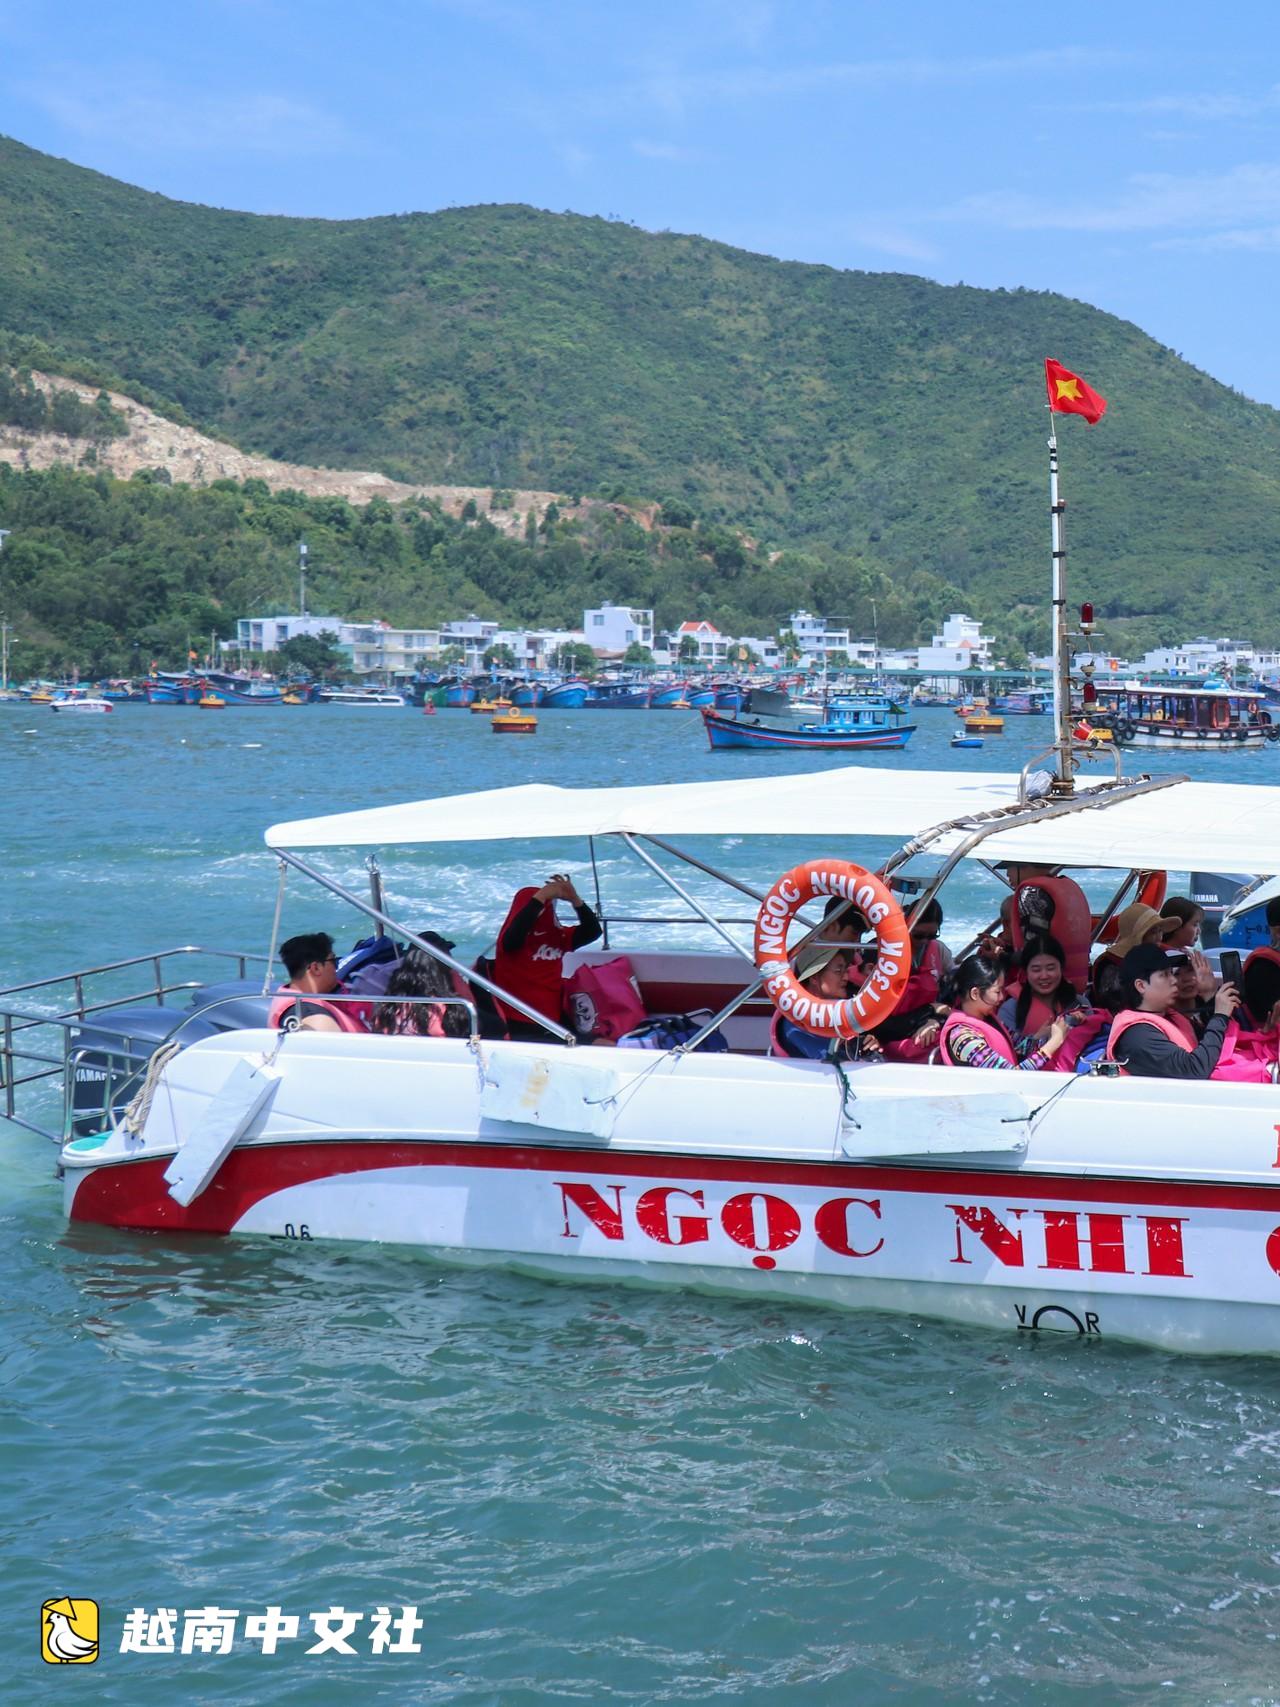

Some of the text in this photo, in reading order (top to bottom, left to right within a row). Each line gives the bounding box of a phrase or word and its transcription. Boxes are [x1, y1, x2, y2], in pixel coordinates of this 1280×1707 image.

[759, 879, 800, 955] NGỌC
[1194, 894, 1219, 903] YAMAHA
[553, 1181, 884, 1271] NGỌC
[945, 1204, 1194, 1277] NHI
[1084, 1311, 1101, 1334] R
